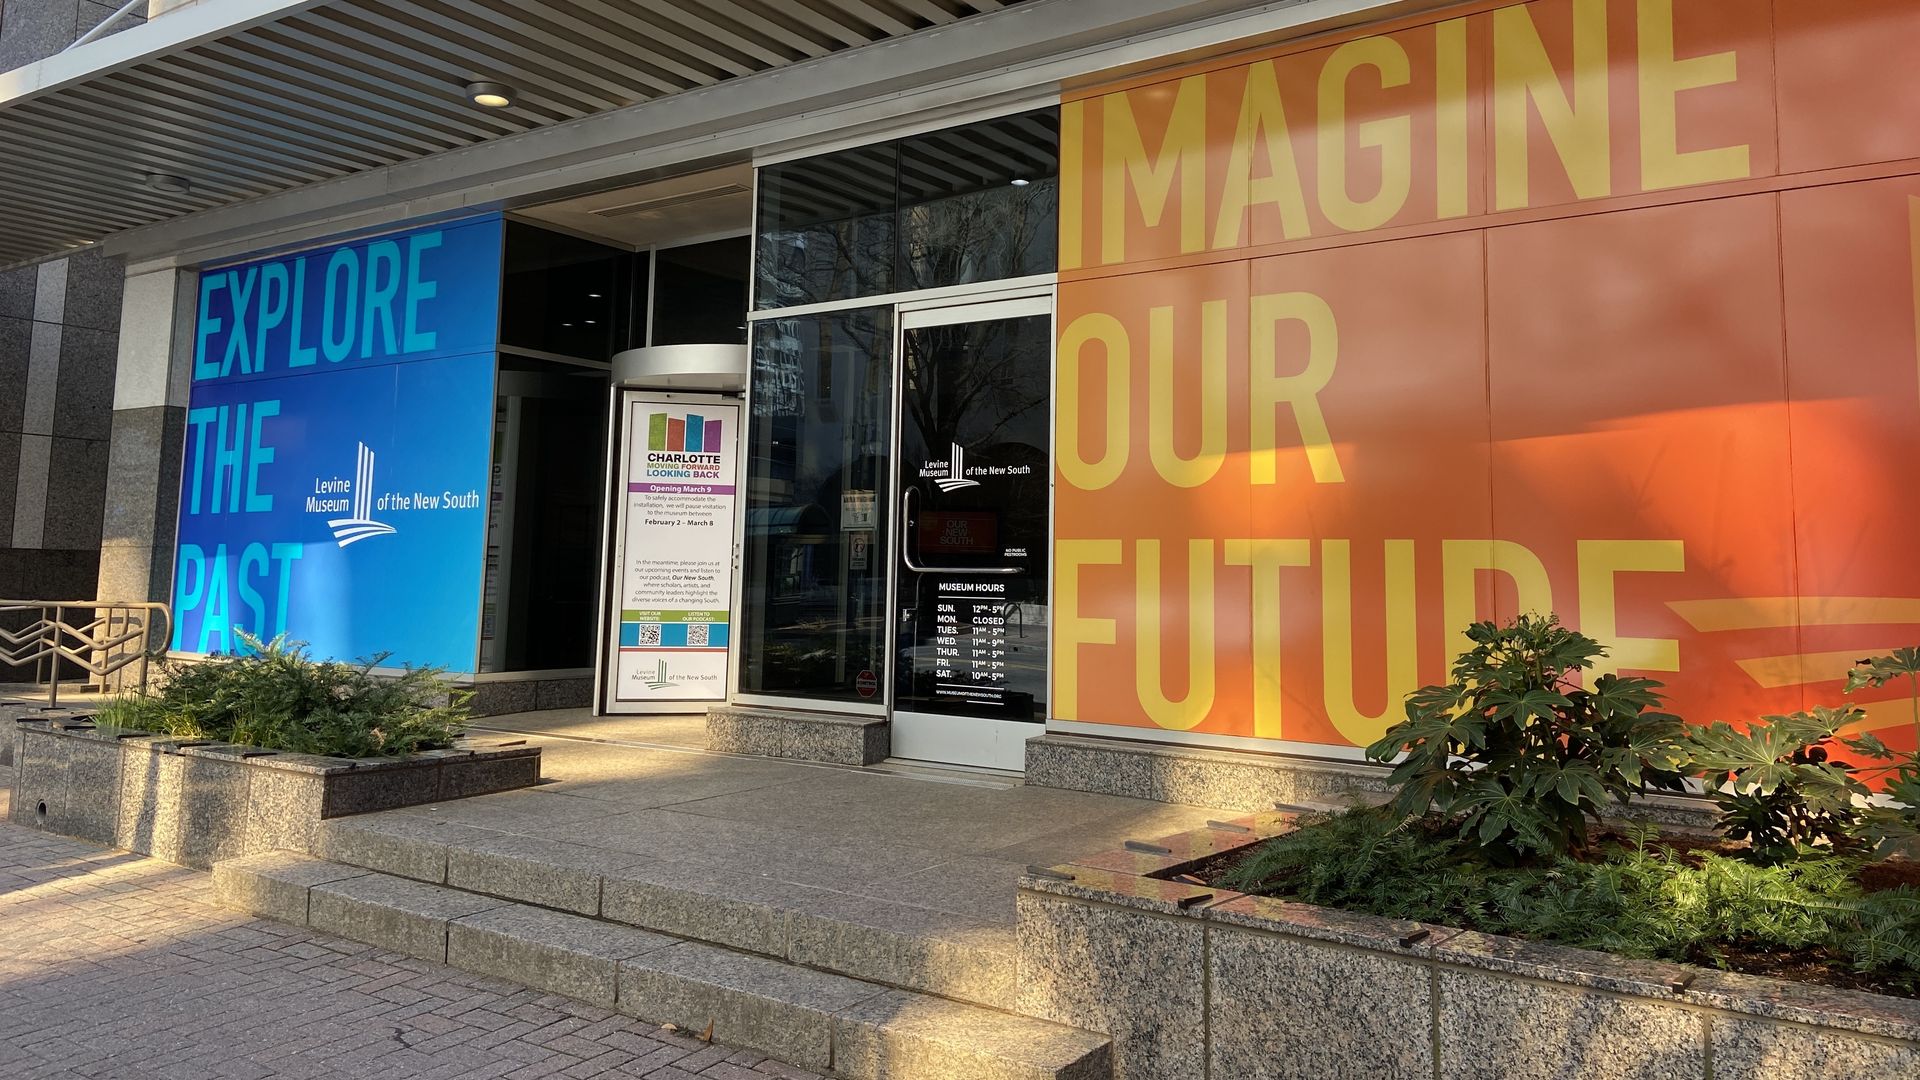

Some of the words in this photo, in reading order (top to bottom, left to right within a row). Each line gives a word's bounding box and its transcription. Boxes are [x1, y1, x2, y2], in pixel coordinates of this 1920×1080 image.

[1059, 0, 1750, 269] IMAGINE
[193, 231, 442, 381] EXPLORE
[1055, 291, 1345, 490] OUR
[189, 400, 280, 514] THE
[648, 453, 720, 464] CHARLOTTE
[924, 460, 948, 468] Levine
[919, 468, 948, 477] Museum
[966, 467, 974, 475] of
[975, 467, 987, 475] the
[989, 466, 1005, 474] New
[1007, 465, 1030, 474] South
[315, 477, 350, 494] Levine
[306, 496, 349, 512] Museum
[377, 493, 390, 510] of
[392, 493, 409, 510] the
[414, 492, 440, 510] New
[443, 490, 479, 509] South
[940, 536, 973, 544] SOUTH
[939, 583, 974, 591] MUSEUM
[976, 584, 1004, 592] HOURS
[172, 542, 303, 656] PAST
[937, 626, 958, 634] TUES.
[937, 637, 956, 645] WED.
[936, 648, 959, 656] THUR.
[936, 670, 952, 678] SAT.
